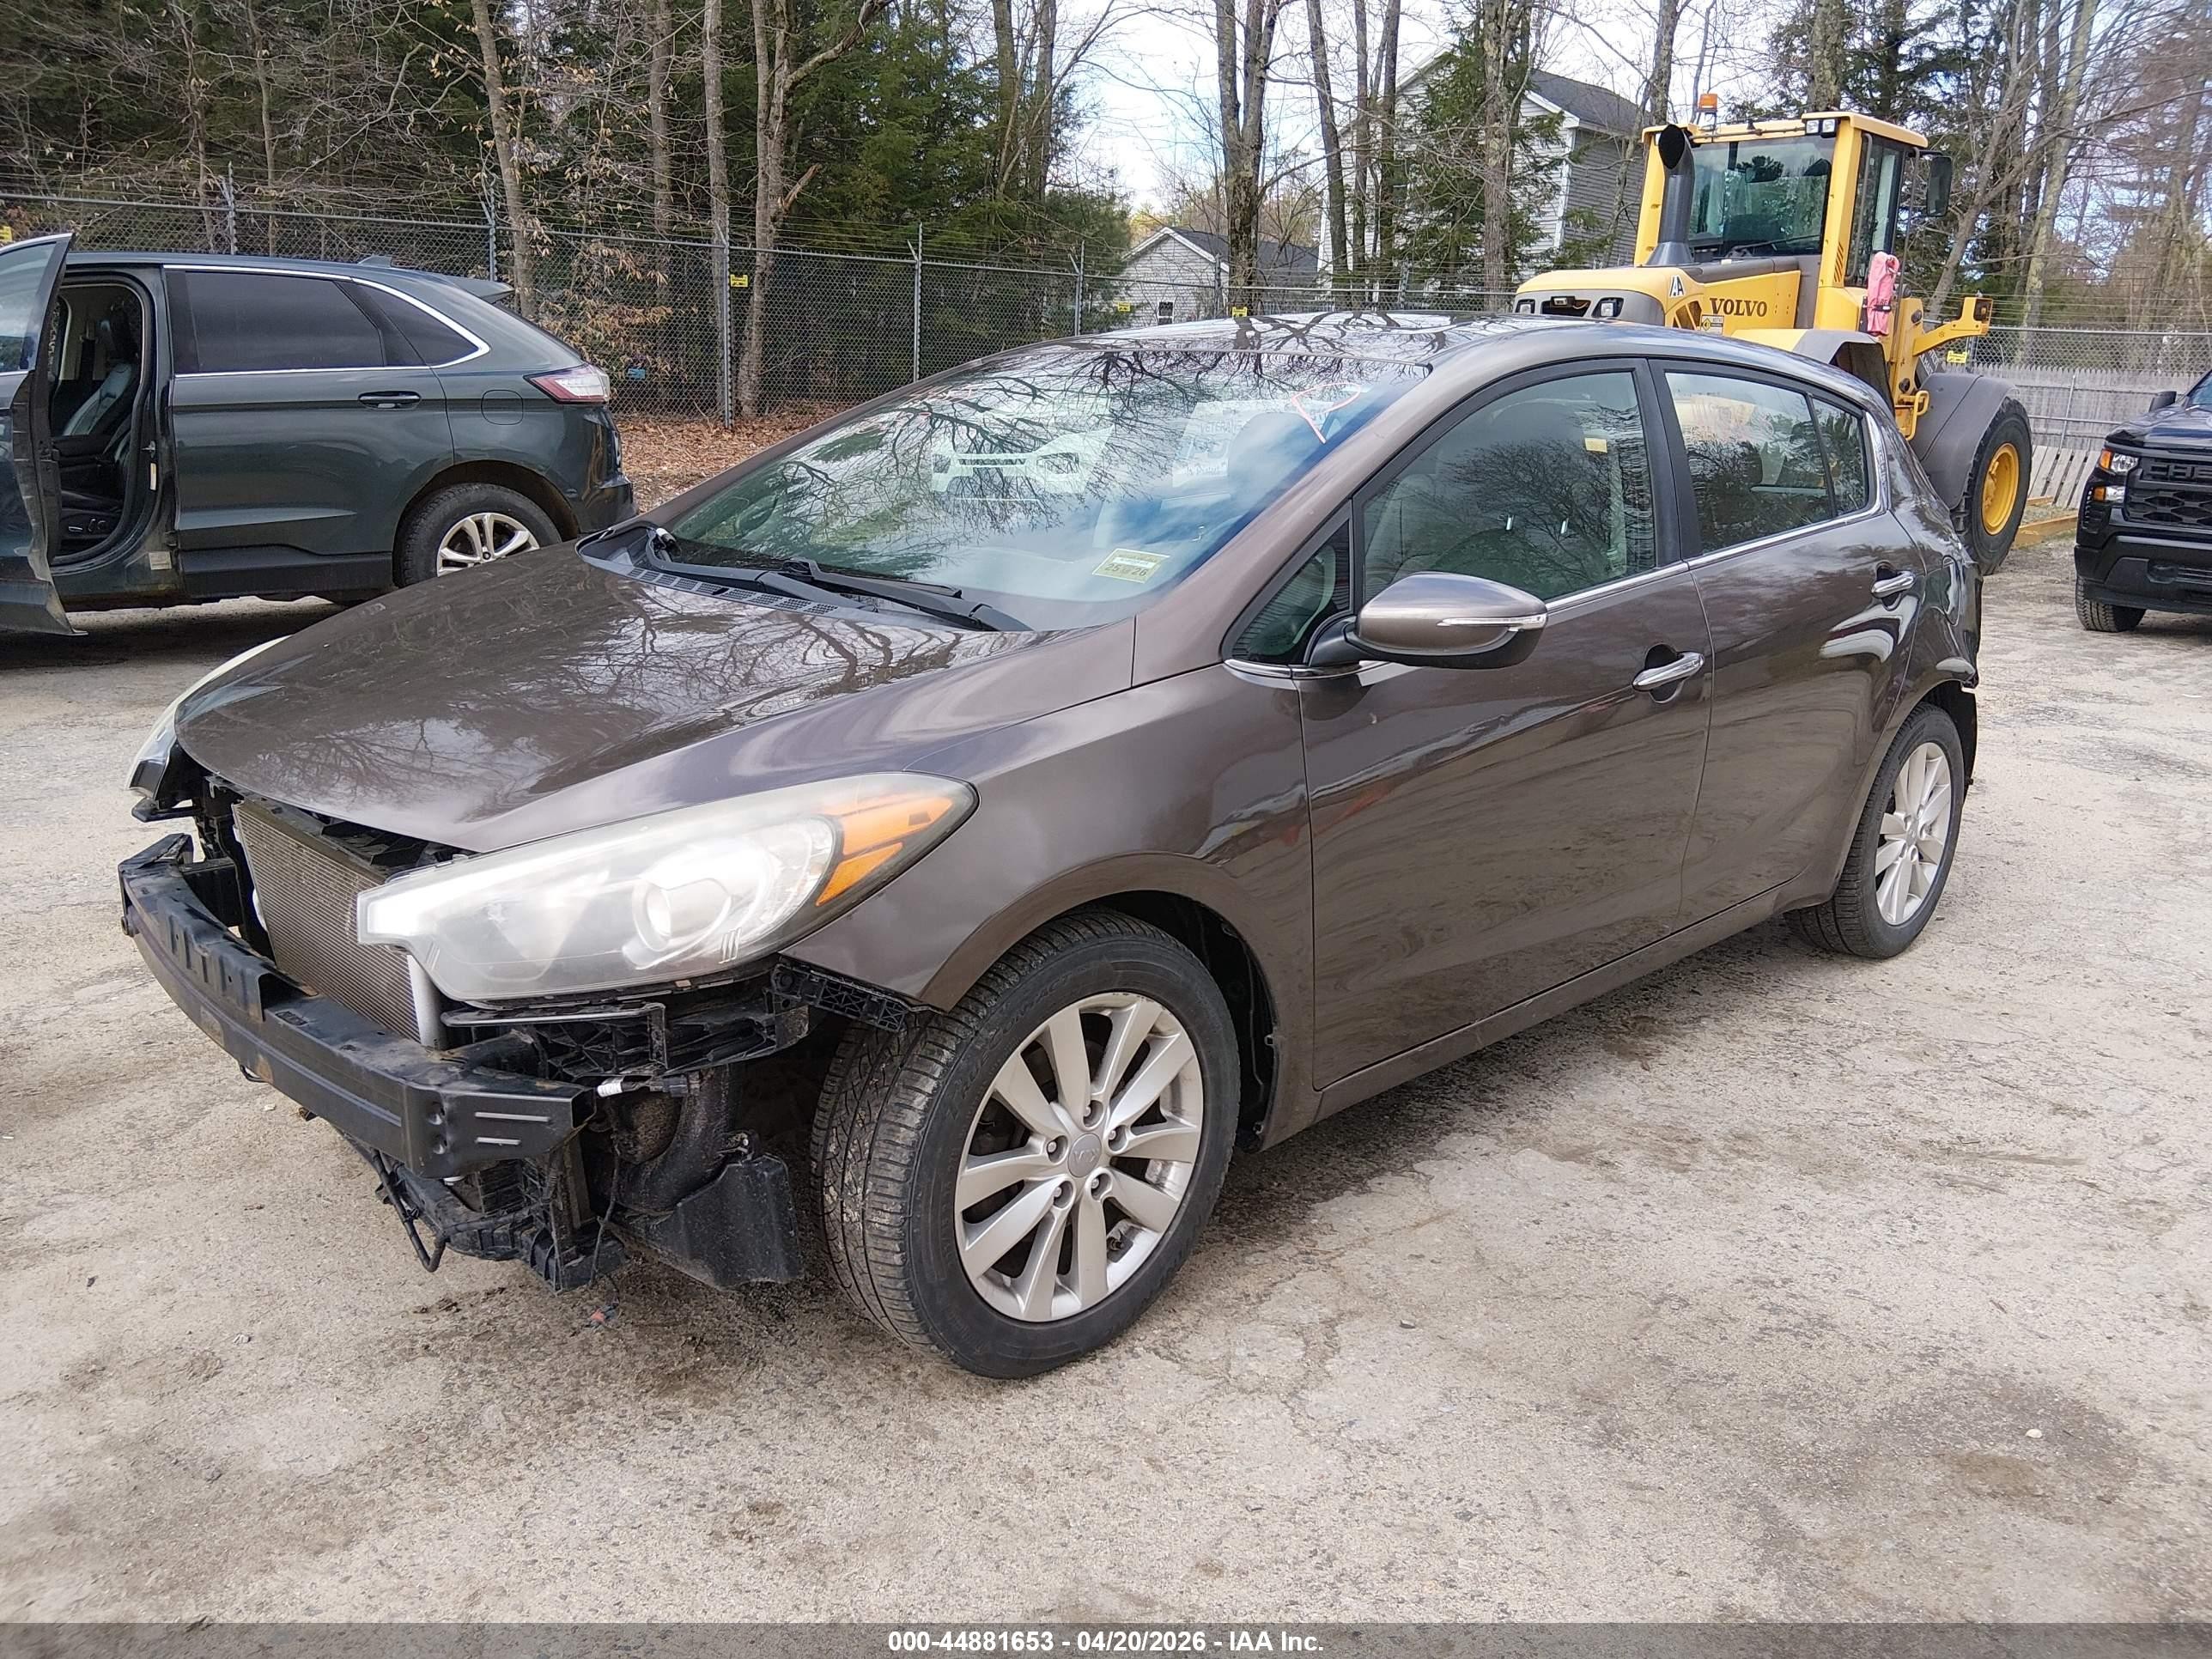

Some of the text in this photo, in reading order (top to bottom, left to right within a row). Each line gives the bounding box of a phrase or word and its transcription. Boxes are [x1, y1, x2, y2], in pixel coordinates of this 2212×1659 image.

[1709, 297, 1768, 317] VOLVO
[1104, 563, 1148, 576] 25 26
